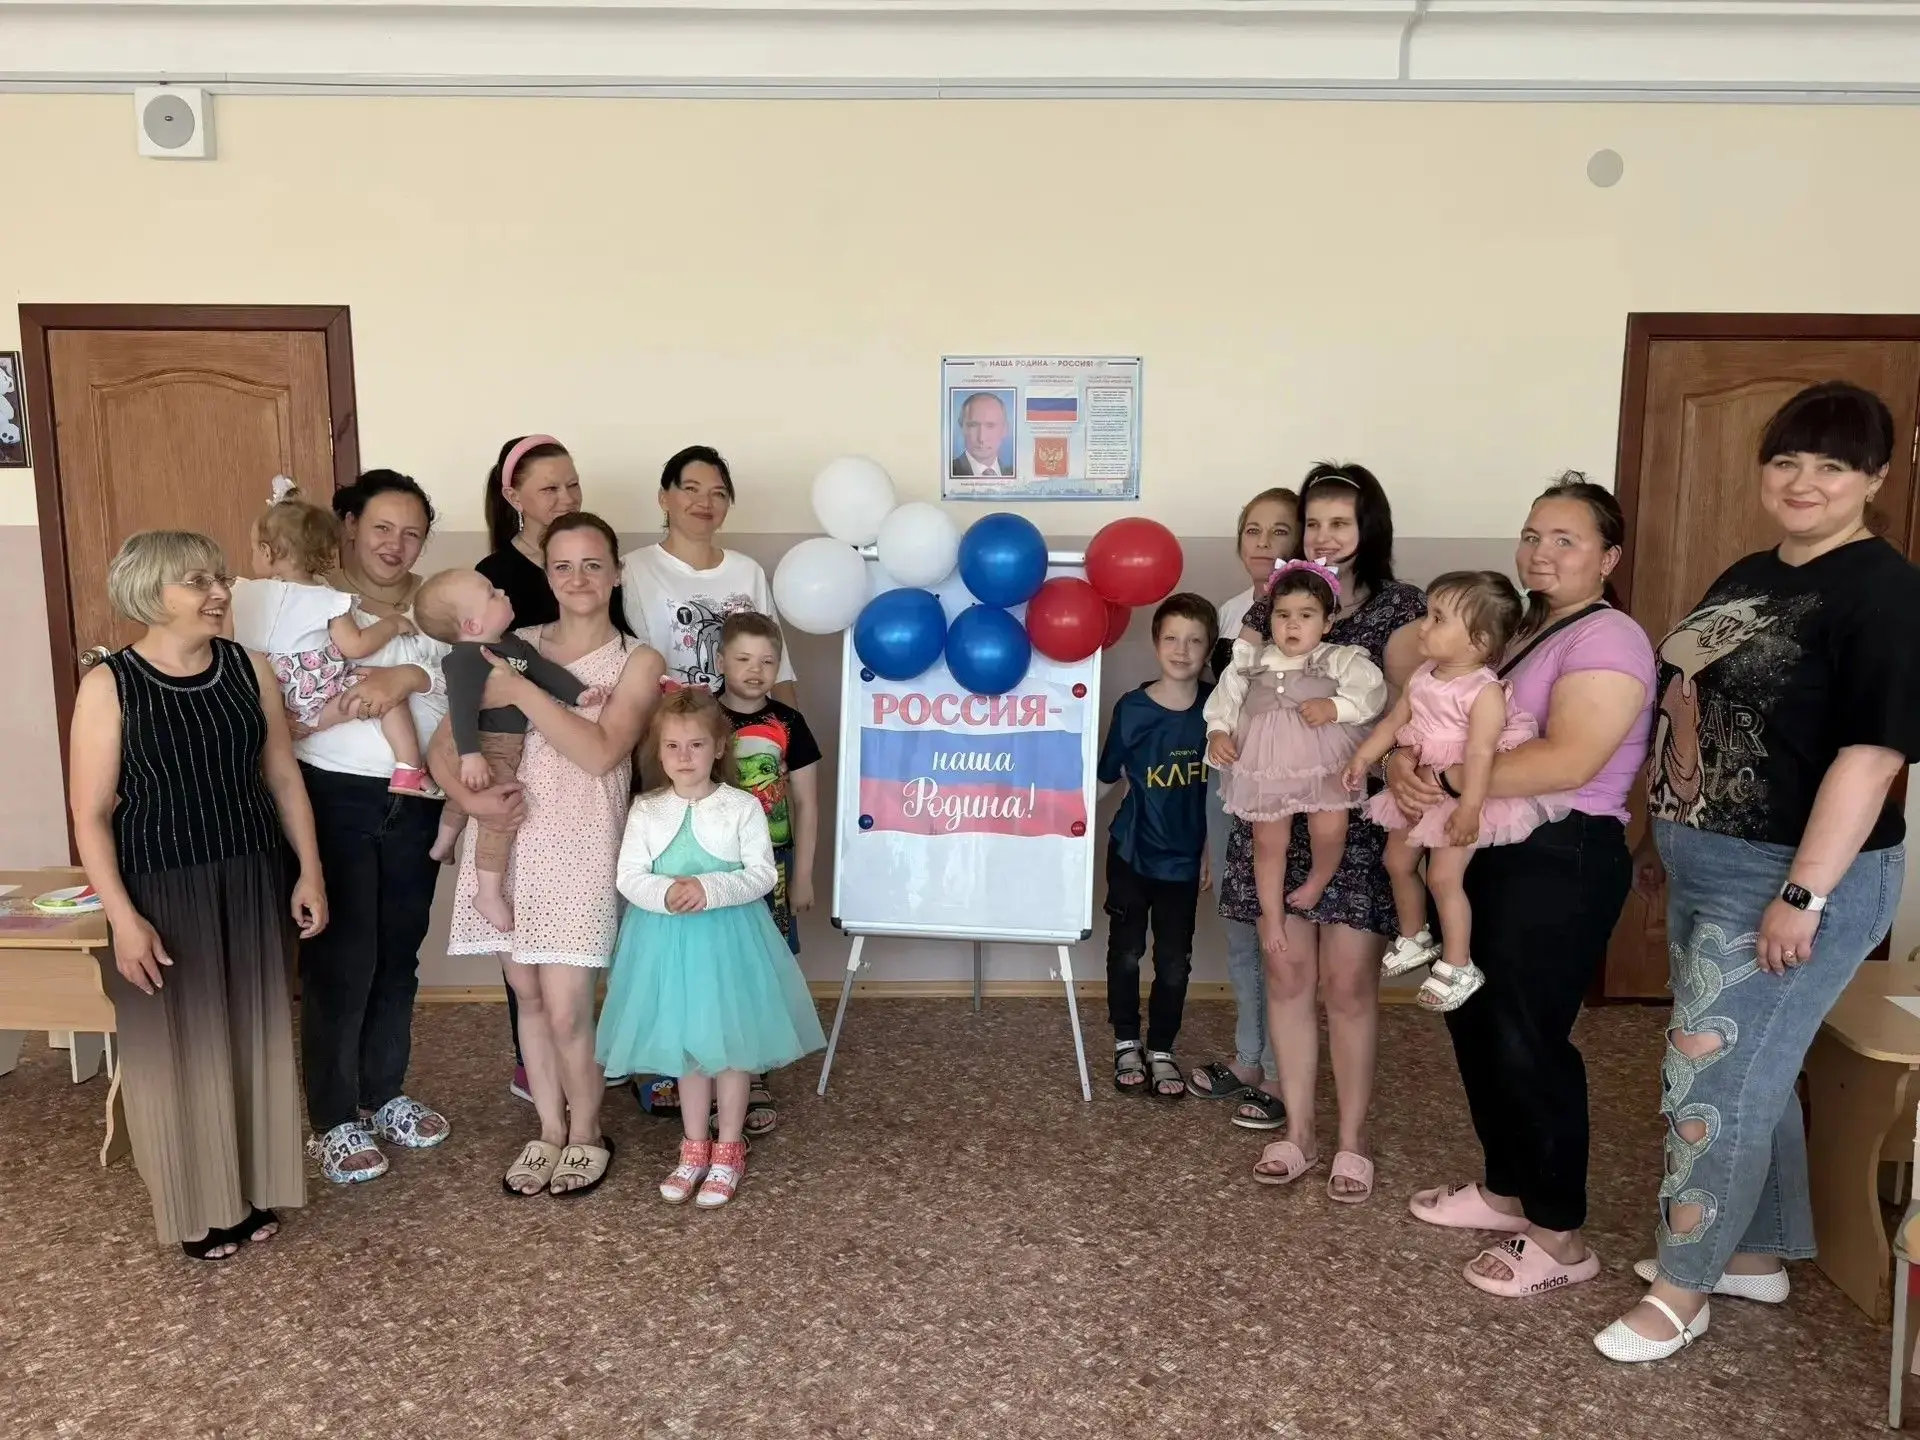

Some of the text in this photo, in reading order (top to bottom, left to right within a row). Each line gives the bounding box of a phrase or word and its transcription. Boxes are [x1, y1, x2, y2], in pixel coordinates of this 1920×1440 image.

[872, 693, 1063, 727] РОССИЯ-
[1699, 700, 1769, 757] AR
[932, 749, 1015, 772] наша
[902, 776, 1035, 831] Родина!
[1530, 1274, 1569, 1292] adidas
